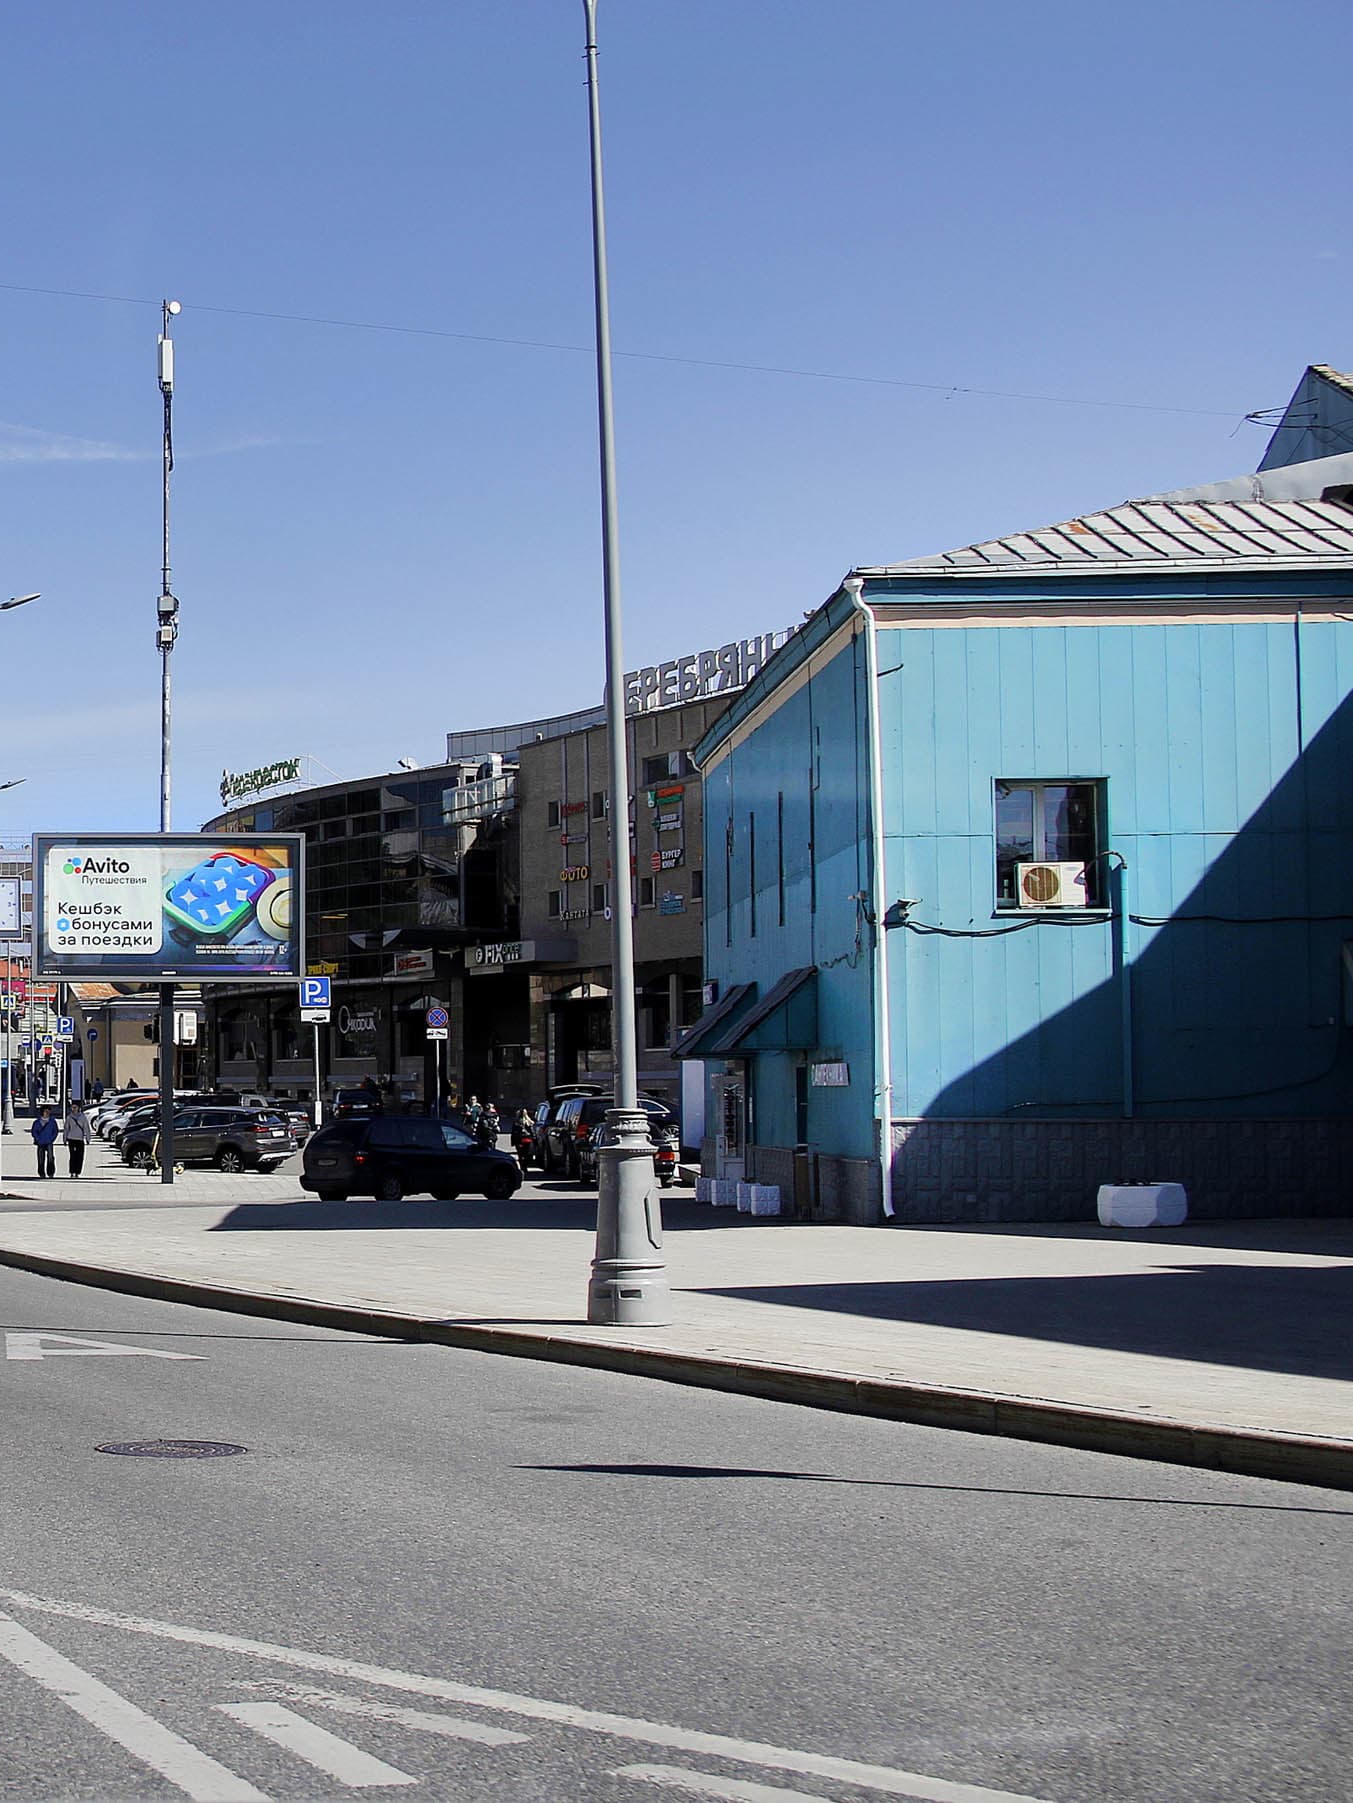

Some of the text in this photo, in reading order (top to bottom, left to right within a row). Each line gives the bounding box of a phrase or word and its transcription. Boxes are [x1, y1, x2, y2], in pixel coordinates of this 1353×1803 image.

[623, 622, 808, 716] ЕРЕБРЯН
[82, 857, 130, 874] Avito
[81, 875, 148, 886] Путешествия
[57, 901, 123, 915] Кешбэк
[71, 917, 154, 934] бонусами
[57, 935, 154, 948] за поездки
